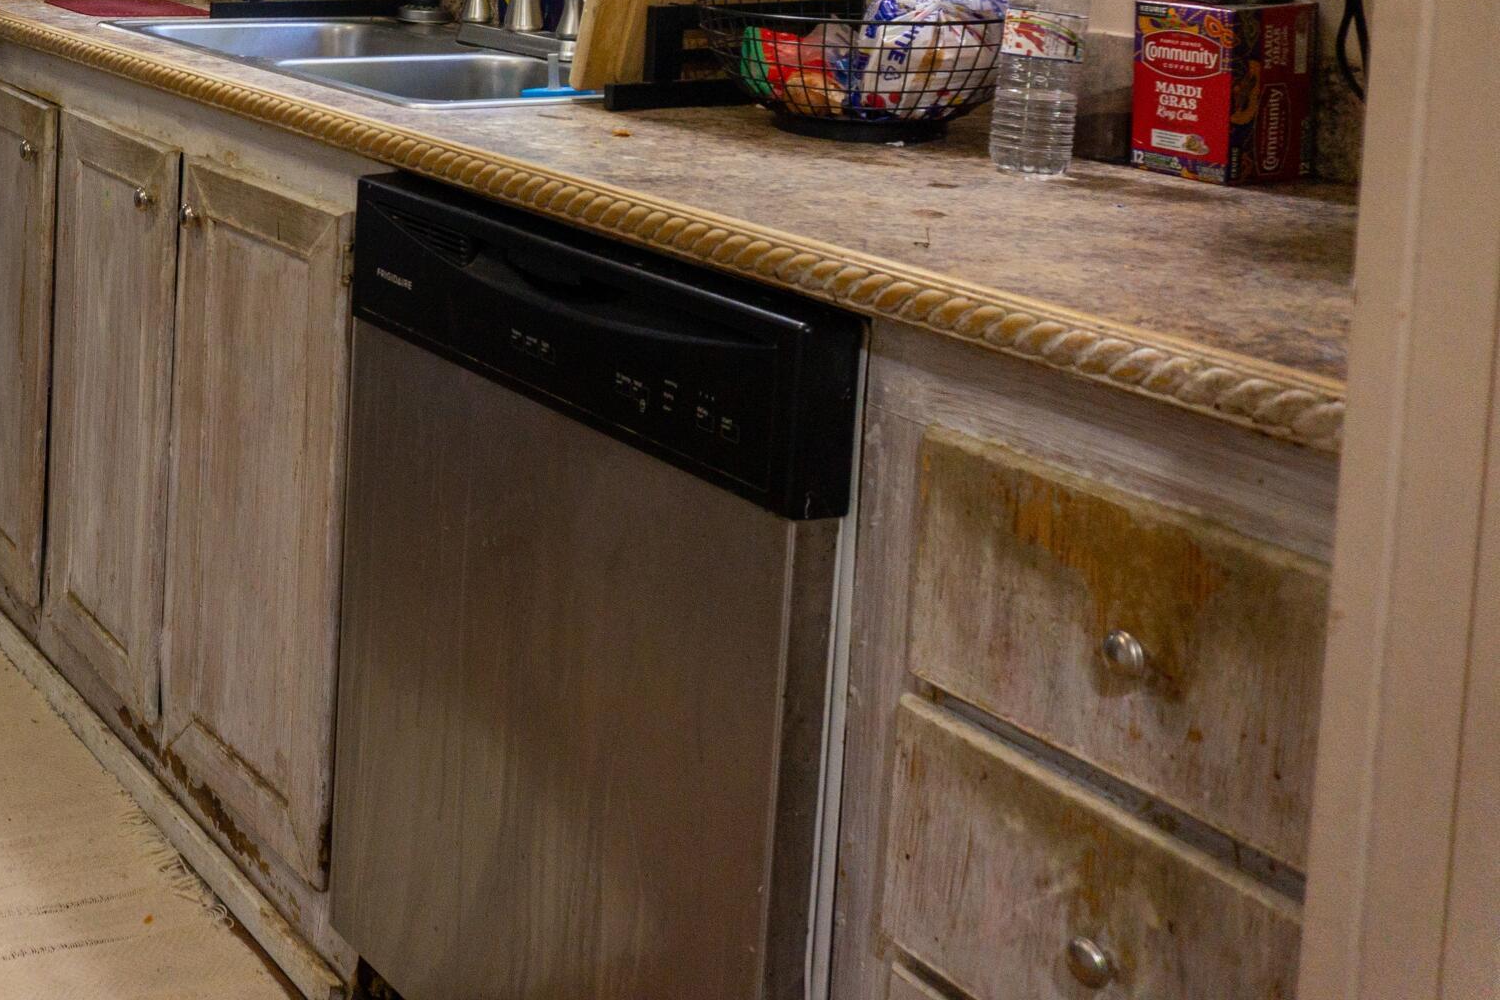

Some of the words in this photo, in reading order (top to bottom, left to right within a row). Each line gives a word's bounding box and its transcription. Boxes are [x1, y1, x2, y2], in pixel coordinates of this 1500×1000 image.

[1140, 5, 1167, 14] KEURIG
[1264, 24, 1273, 69] MARDI
[1145, 41, 1218, 69] Community
[1163, 63, 1196, 72] COFFEE
[1156, 81, 1202, 98] MARDI
[1159, 94, 1197, 110] GRAS
[1263, 88, 1283, 171] Community
[1131, 150, 1145, 164] 12
